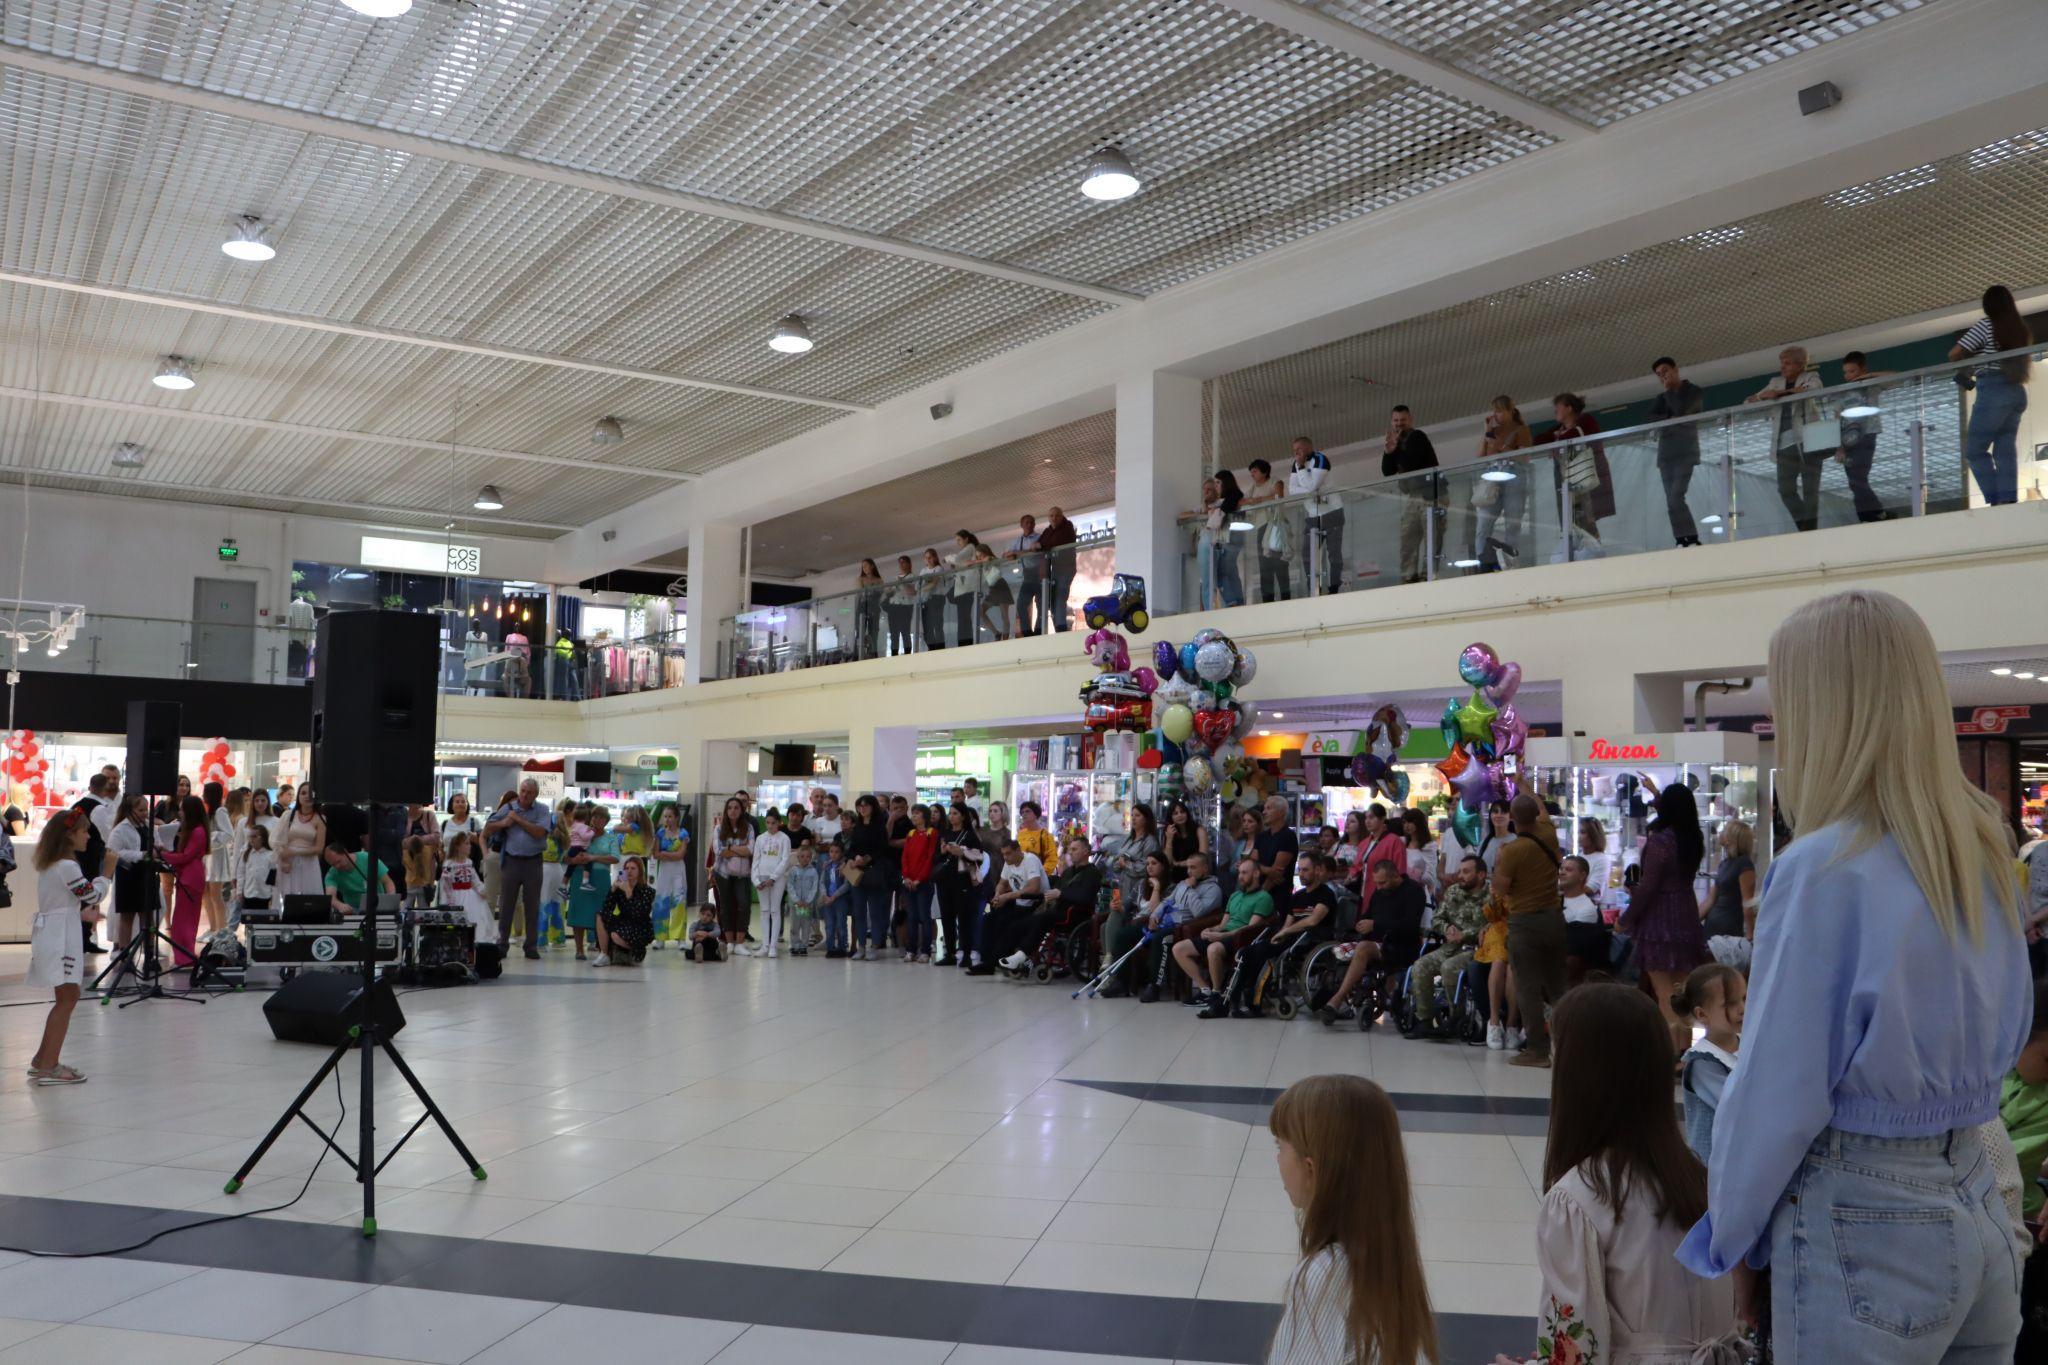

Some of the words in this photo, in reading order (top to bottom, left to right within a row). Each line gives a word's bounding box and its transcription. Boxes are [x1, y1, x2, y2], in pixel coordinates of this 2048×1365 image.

[448, 548, 477, 560] COS
[448, 560, 477, 571] MOS
[1588, 739, 1660, 760] Янгол
